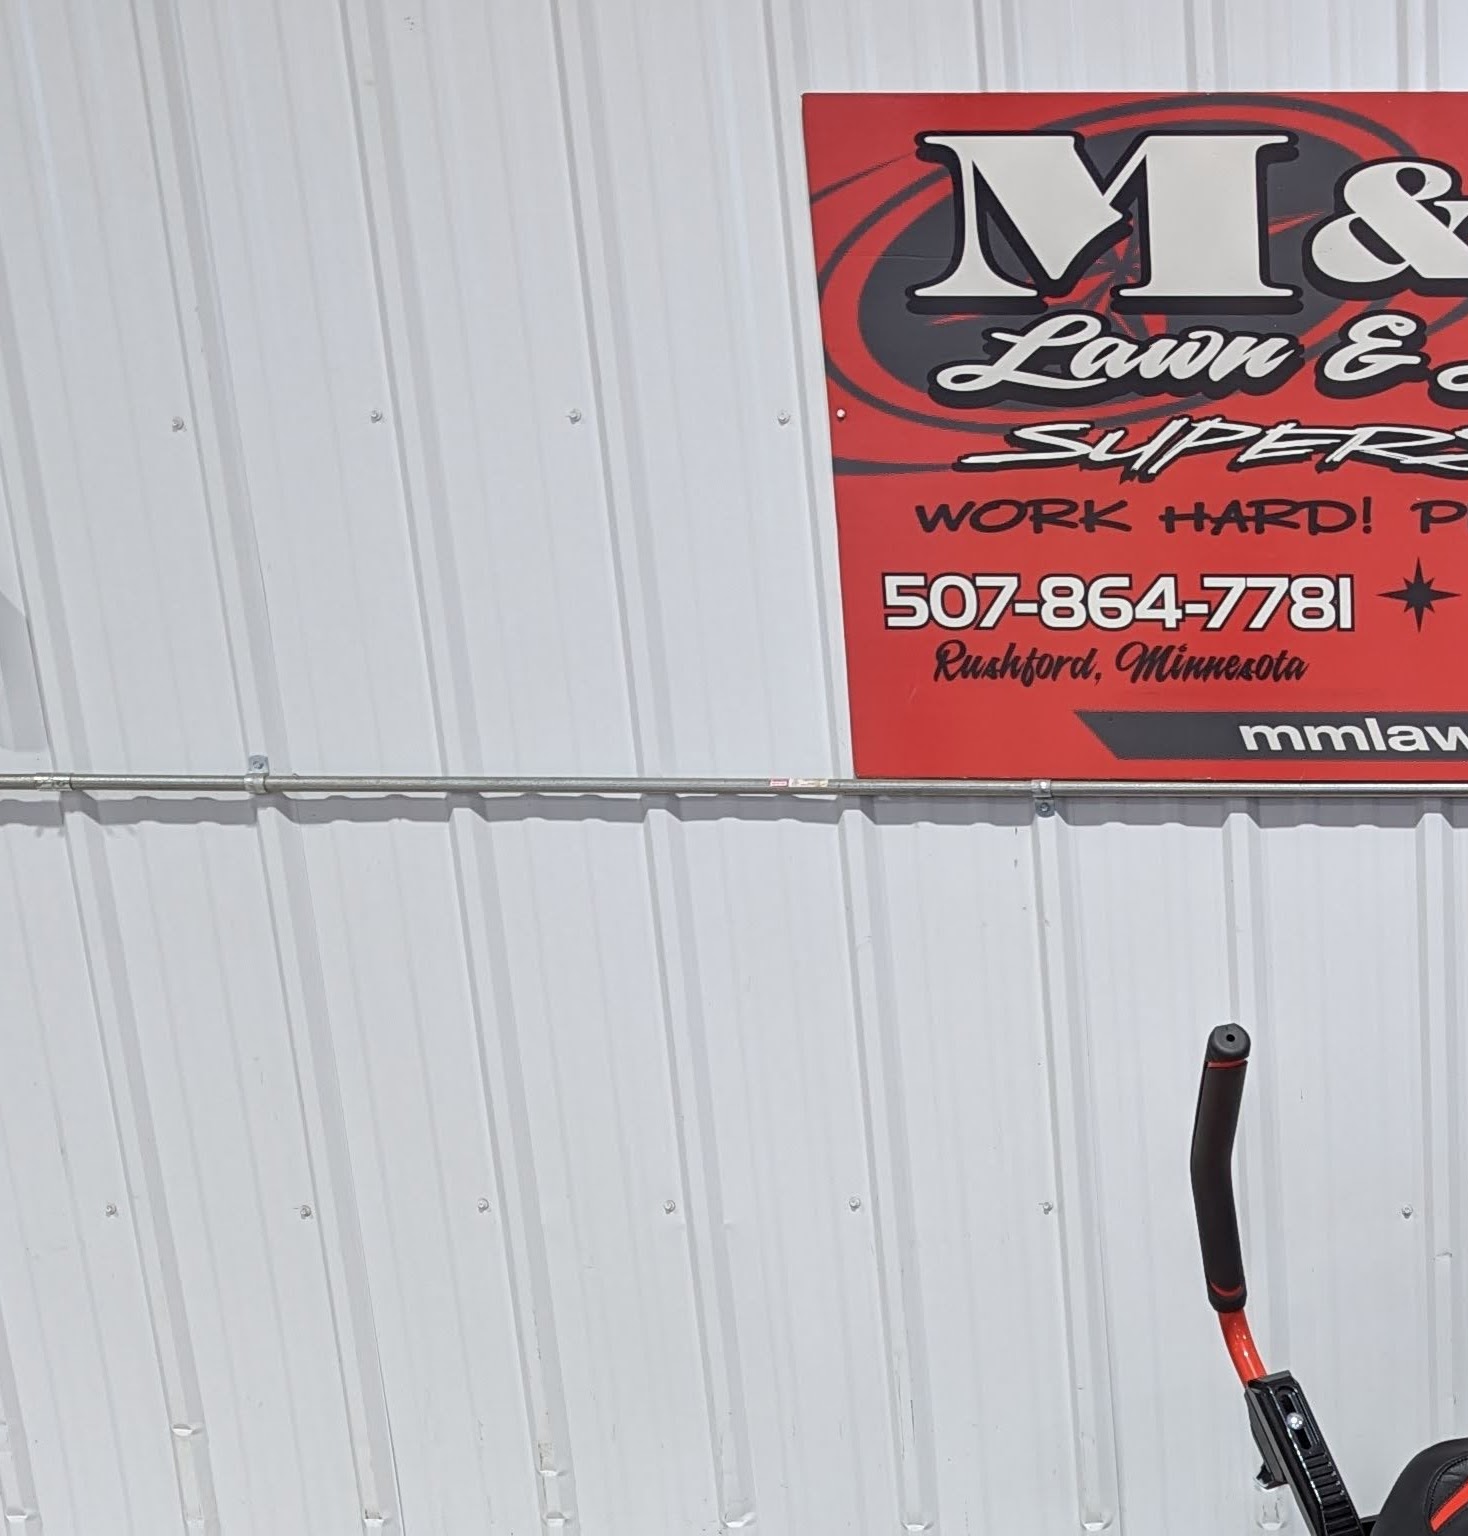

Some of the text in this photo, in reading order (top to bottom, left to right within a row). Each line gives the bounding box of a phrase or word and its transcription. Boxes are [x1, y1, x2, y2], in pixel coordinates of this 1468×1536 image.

[937, 314, 1295, 392] Lawn
[1323, 314, 1422, 382] &
[915, 498, 1132, 534] WORK
[1158, 496, 1373, 536] HARD!
[884, 574, 1353, 630] 507-864-7781
[933, 638, 1308, 687] Rushford, Minnesota
